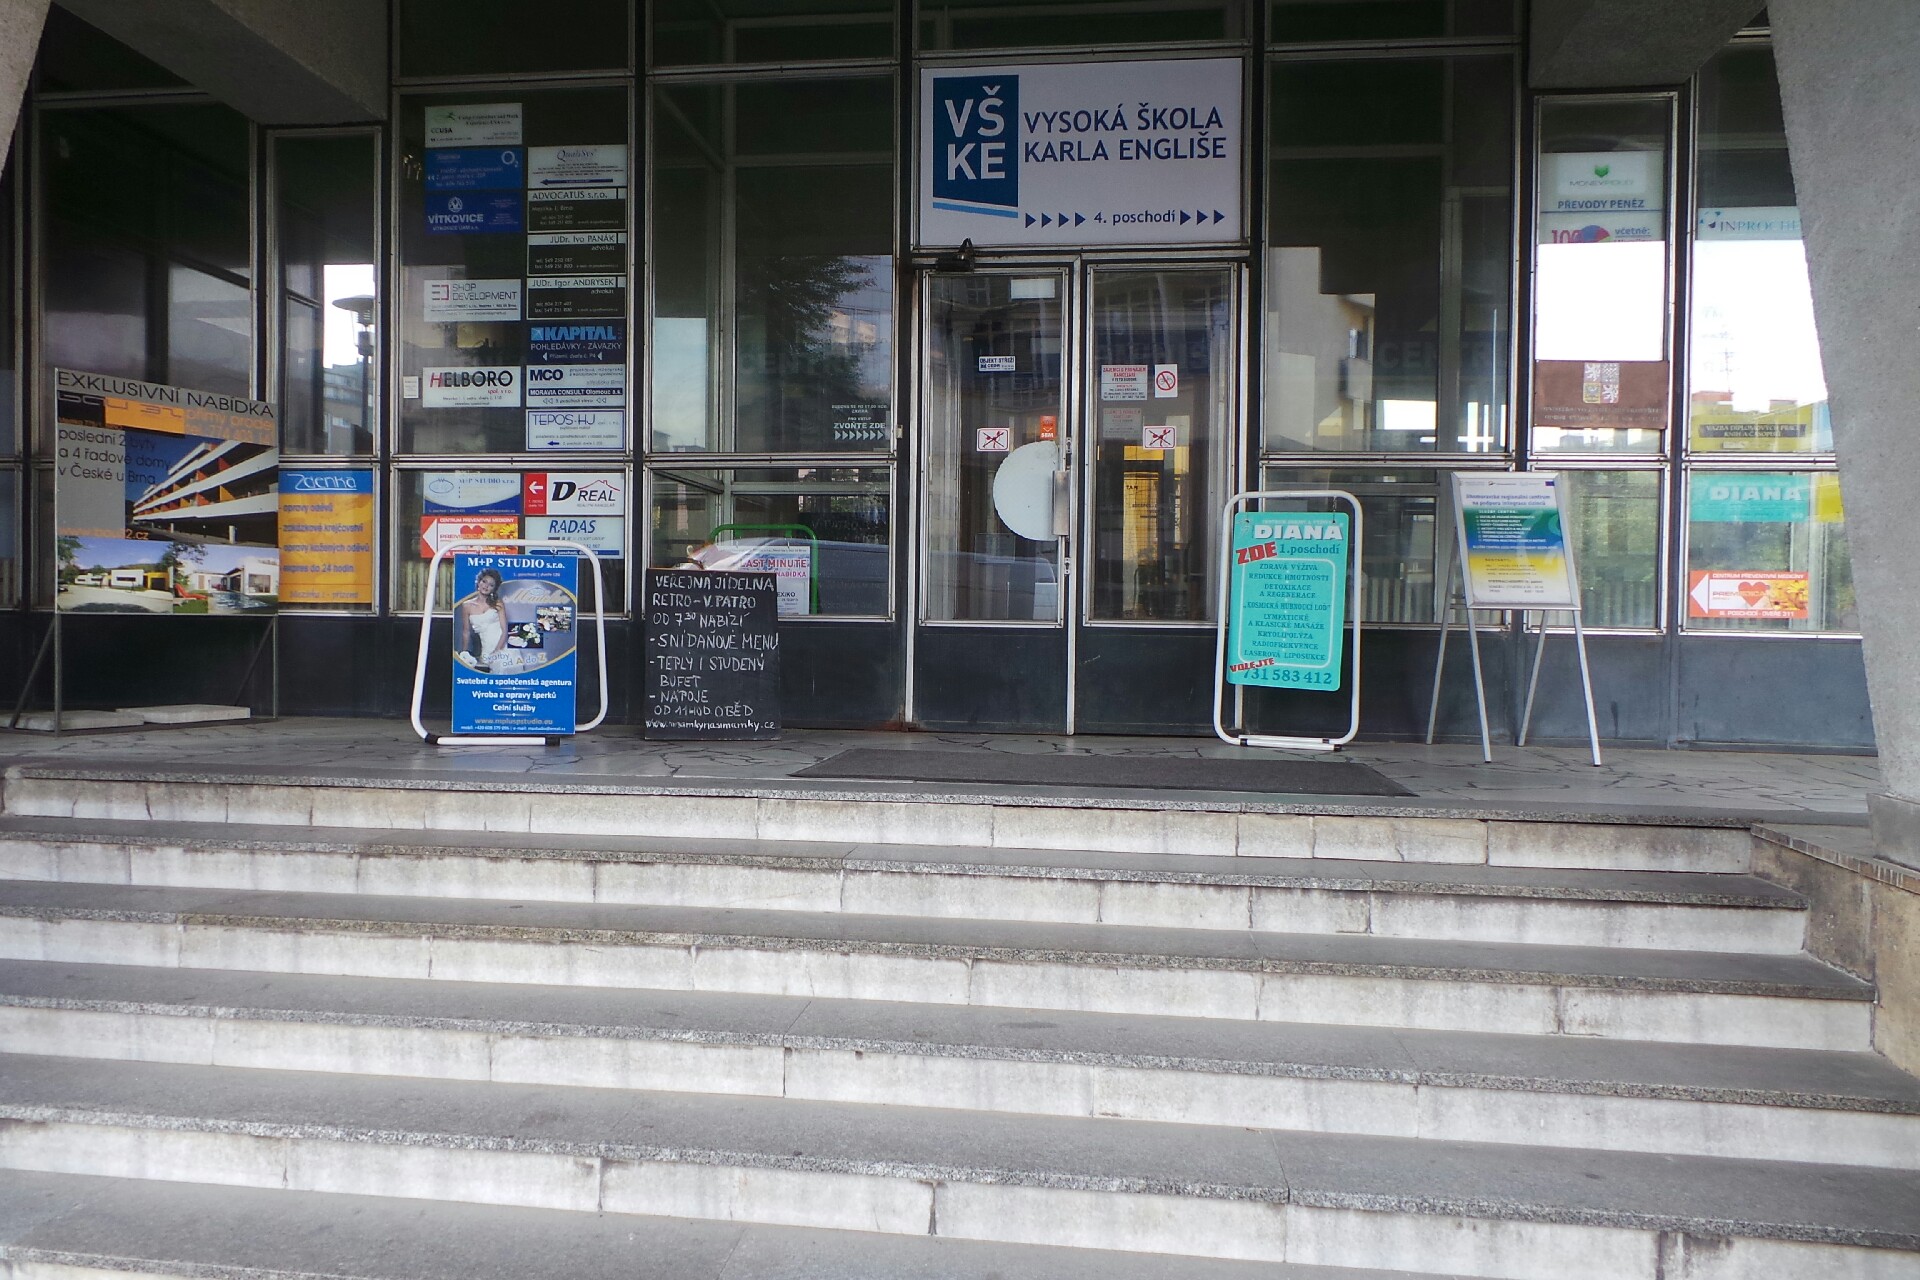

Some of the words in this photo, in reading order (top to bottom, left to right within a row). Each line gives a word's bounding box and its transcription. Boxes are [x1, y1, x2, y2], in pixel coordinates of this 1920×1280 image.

[944, 84, 1006, 138] VŠ
[1023, 103, 1128, 134] VYSOKÁ
[1137, 102, 1224, 131] ŠKOLA
[1024, 139, 1109, 163] KARLA
[1119, 131, 1227, 160] ENGLIŠE
[946, 141, 1006, 181] KE
[532, 191, 585, 200] ADVOCATUS
[587, 191, 608, 199] s.r.o.
[1557, 199, 1607, 209] PŘEVODY
[1609, 198, 1645, 209] PENĚZ
[428, 213, 484, 224] VÍTKOVICE
[1093, 213, 1107, 224] 4.
[1112, 209, 1176, 226] poschodí
[550, 235, 569, 243] JUDr.
[573, 235, 585, 243] Ivo
[587, 234, 615, 243] PANÁK
[452, 282, 477, 292] SHOP
[532, 279, 551, 287] JUDr.
[555, 279, 570, 288] Igor
[452, 291, 518, 301] DEVELOPMENT
[545, 325, 617, 341] KAPITAL
[530, 341, 582, 351] POHLEDÁVKY
[587, 341, 622, 350] ZÁVAZKY
[429, 370, 513, 388] HELBORO
[529, 368, 564, 381] MCO
[57, 370, 180, 404] EXKLUSIVNÍ
[187, 391, 275, 419] NABÍDKA
[585, 387, 611, 395] Olomouc
[833, 421, 868, 429] ZVOŇTE
[58, 428, 116, 445] poslední
[120, 435, 127, 447] 2
[58, 449, 69, 459] a
[72, 447, 81, 460] 4
[84, 447, 133, 466] řadové
[58, 467, 66, 476] v
[70, 461, 113, 481] České
[116, 472, 125, 482] u
[127, 470, 157, 485] Brna
[551, 481, 577, 502] D
[577, 489, 616, 502] REAL
[1710, 486, 1802, 501] DIANA
[283, 503, 309, 513] opravy
[310, 502, 334, 512] oděvů
[549, 519, 596, 534] RADAS
[1253, 524, 1344, 541] DIANA
[283, 544, 309, 553] opravy
[310, 543, 346, 553] kožených
[1235, 541, 1278, 565] ZDE
[310, 564, 320, 572] do
[322, 564, 332, 572] 24
[333, 563, 354, 572] hodin
[467, 557, 494, 567] M+P
[497, 558, 545, 569] STUDIO
[768, 559, 807, 568] MINUTE
[1259, 563, 1288, 571] ZDRAVÁ
[1291, 563, 1318, 571] VÝŽIVA
[655, 573, 711, 590] VEŘEJNÁ
[714, 573, 775, 592] JÍDELNA
[1284, 573, 1329, 581] HMOTNOSTI
[1264, 583, 1312, 591] DETOXIKACE
[652, 592, 692, 607] RETRO
[714, 595, 757, 610] PATRO
[1266, 591, 1316, 599] REGENERACE
[653, 612, 670, 626] OD
[699, 611, 750, 628] NABÍZÍ
[1263, 613, 1309, 621] LYMFATICKÉ
[1255, 620, 1292, 629] KLASICKÉ
[1293, 621, 1325, 630] MASÁŽE
[741, 632, 779, 651] MENU
[1252, 640, 1319, 650] RADIOFREKVENCE
[482, 652, 510, 663] Svatby
[502, 659, 513, 668] od
[516, 657, 523, 665] A
[525, 655, 537, 664] do
[539, 653, 547, 662] Z
[656, 651, 694, 671] TEPLÝ
[709, 652, 765, 672] STUDENÝ
[1244, 649, 1280, 658] LASEROVÁ
[1284, 652, 1326, 661] LIPOSUKCE
[1229, 657, 1275, 673] VOLEJTE
[456, 677, 489, 686] Svatební
[494, 677, 540, 686] společenská
[540, 679, 572, 688] agentura
[659, 674, 702, 688] BUFET
[1243, 668, 1269, 681] 731
[1272, 669, 1300, 682] 583
[1303, 671, 1333, 685] 412
[471, 690, 499, 699] Výroba
[505, 692, 531, 700] opravy
[532, 691, 557, 700] šperků
[660, 689, 709, 704] NÁPOJE
[512, 703, 536, 713] služby
[653, 705, 671, 716] OD
[714, 700, 754, 717] OBĚD
